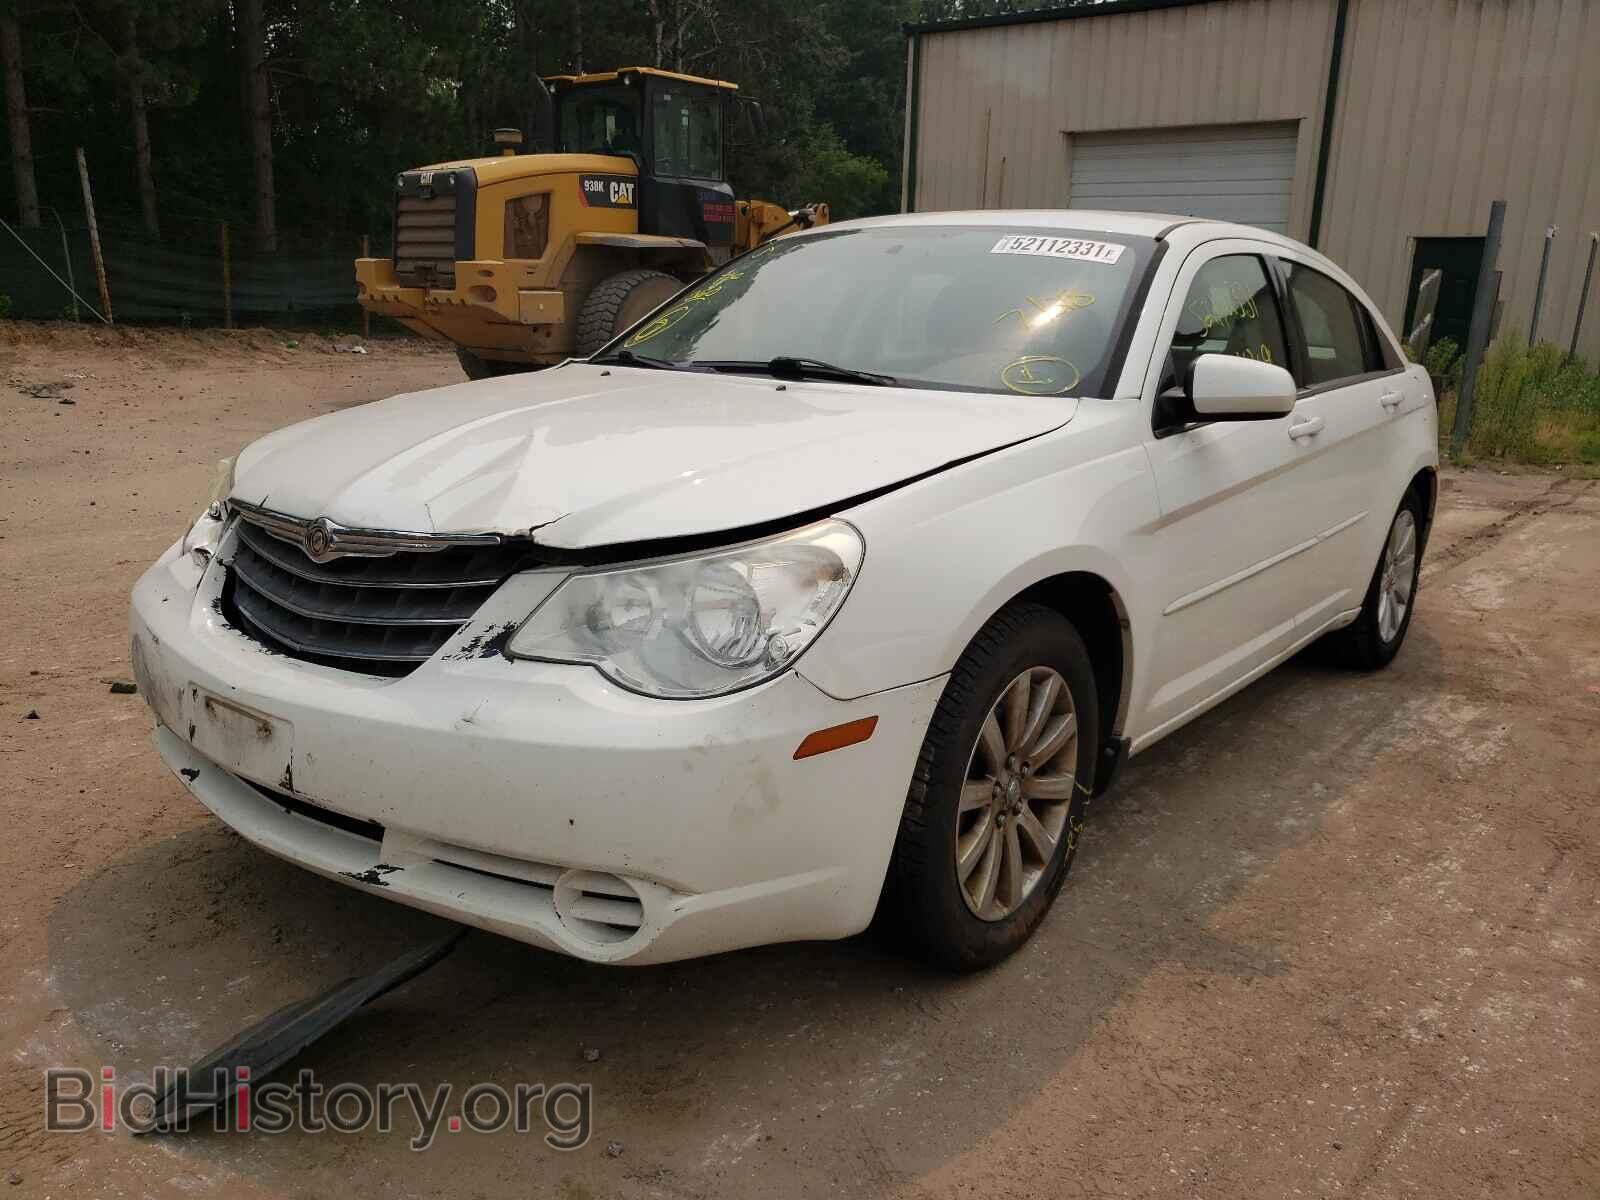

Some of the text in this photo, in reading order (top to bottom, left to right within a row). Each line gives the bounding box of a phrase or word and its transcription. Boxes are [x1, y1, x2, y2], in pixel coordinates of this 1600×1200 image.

[583, 179, 634, 204] 938K CAT
[1010, 237, 1106, 257] 52112331
